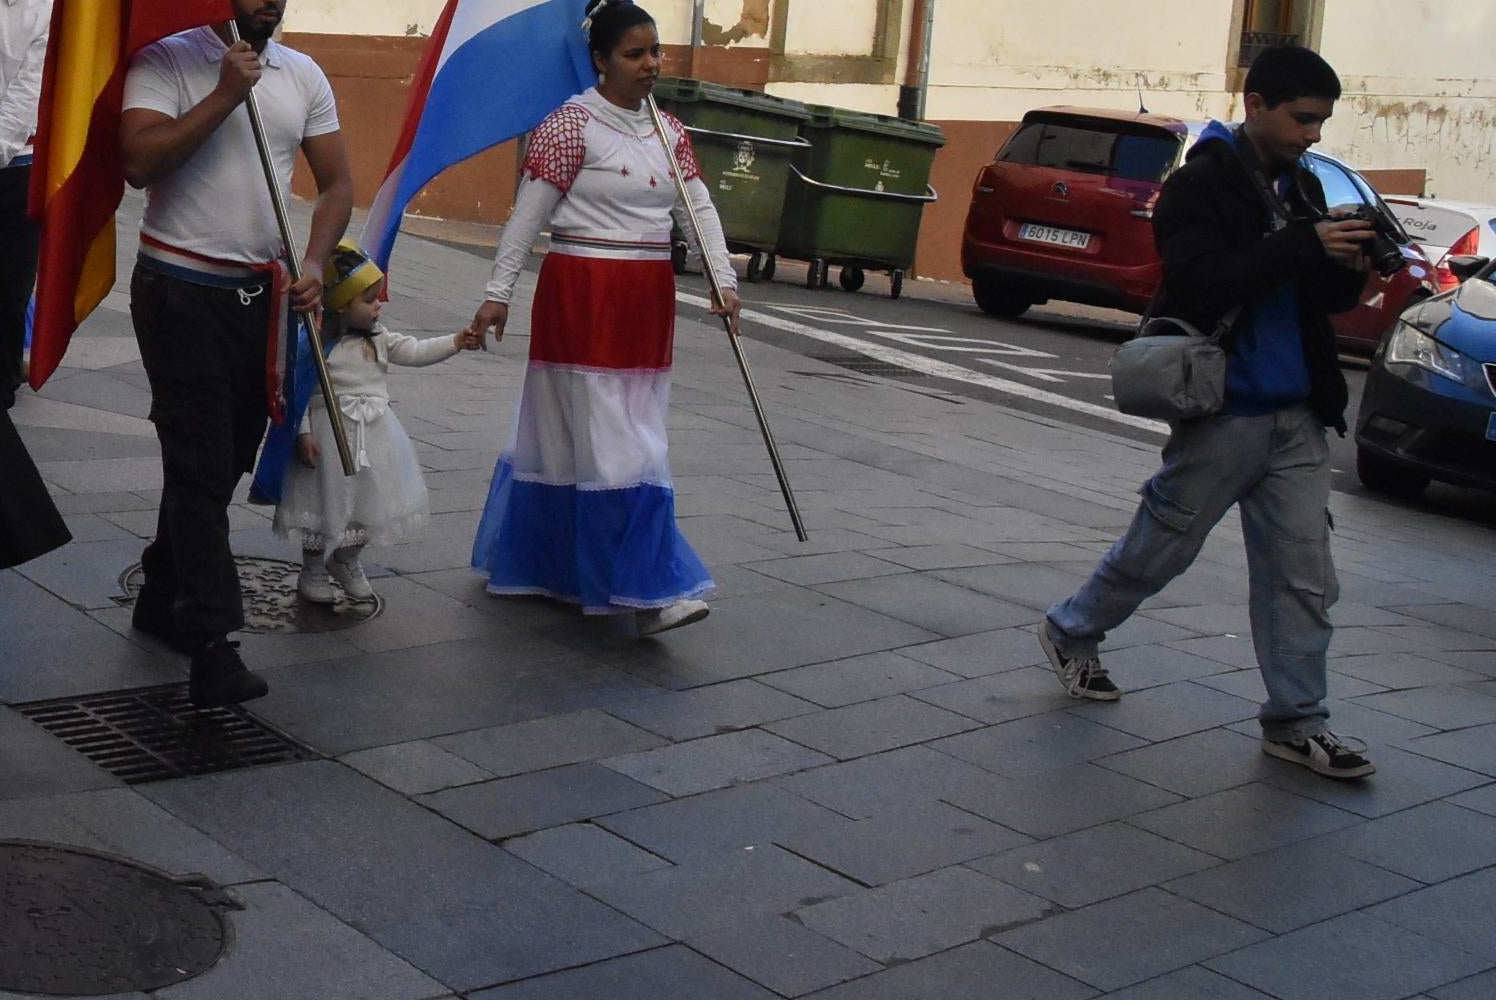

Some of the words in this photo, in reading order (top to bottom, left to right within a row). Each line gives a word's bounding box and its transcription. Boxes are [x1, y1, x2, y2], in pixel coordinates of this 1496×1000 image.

[1403, 217, 1438, 231] Roja
[1027, 226, 1060, 242] 6015
[1060, 231, 1088, 247] LPN
